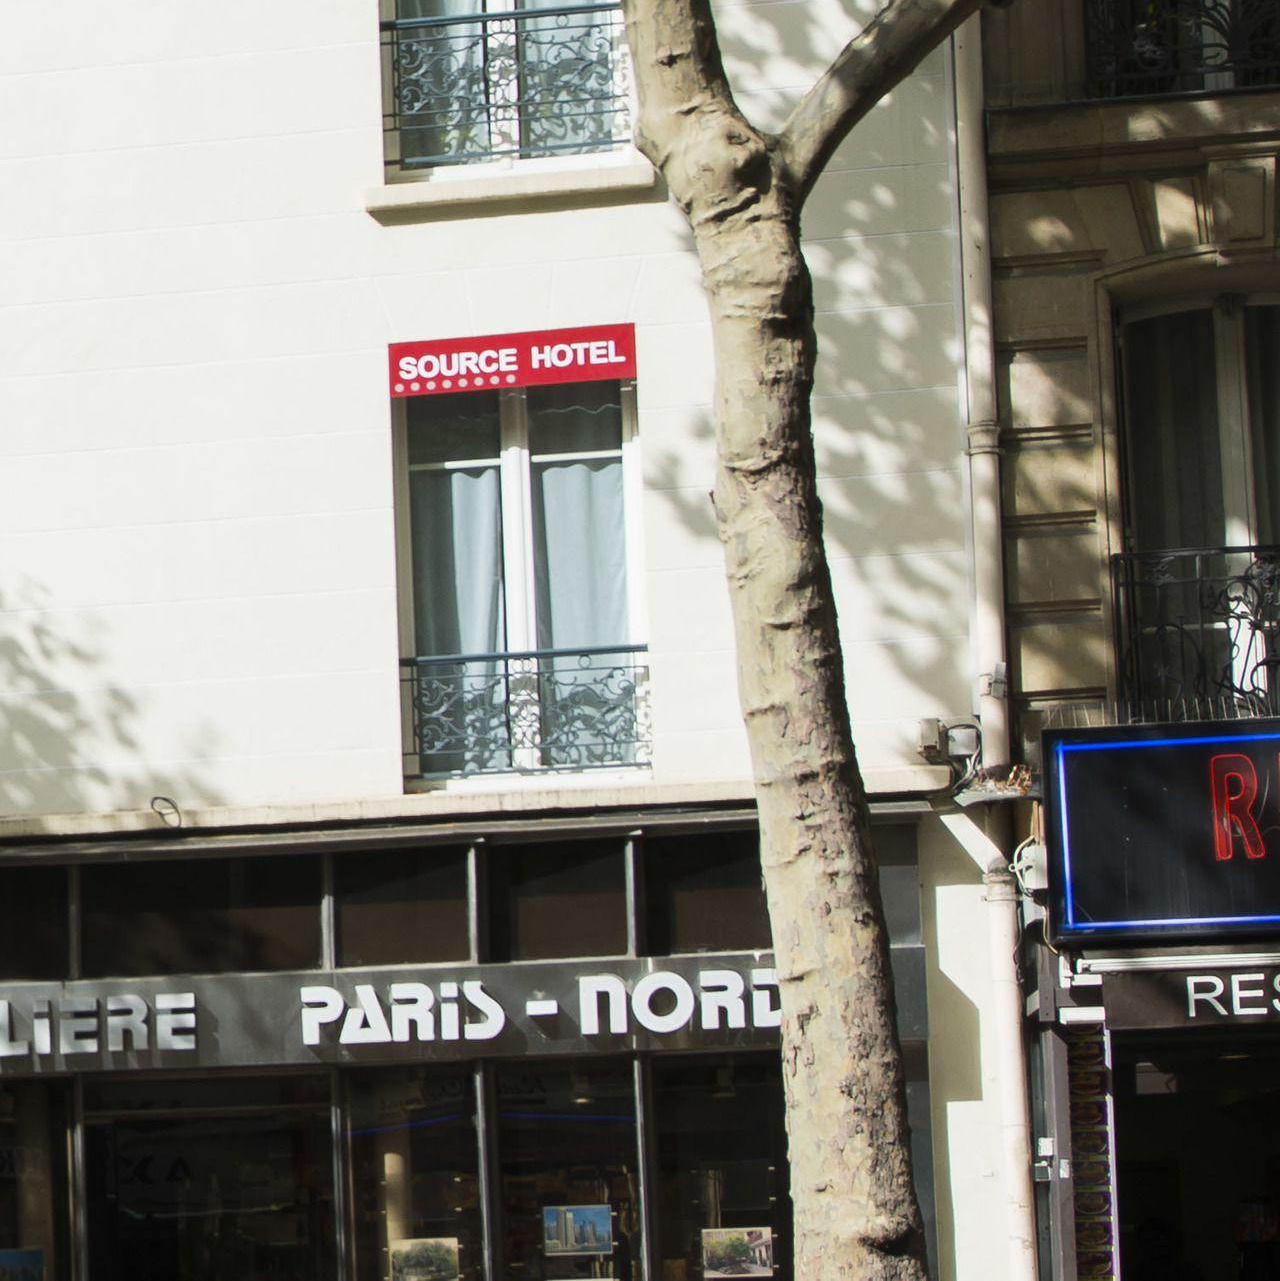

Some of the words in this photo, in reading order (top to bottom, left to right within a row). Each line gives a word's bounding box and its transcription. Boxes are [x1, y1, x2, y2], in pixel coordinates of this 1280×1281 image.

[398, 348, 519, 380] SOURCE
[531, 340, 627, 369] HOTEL
[1186, 972, 1280, 1018] RE
